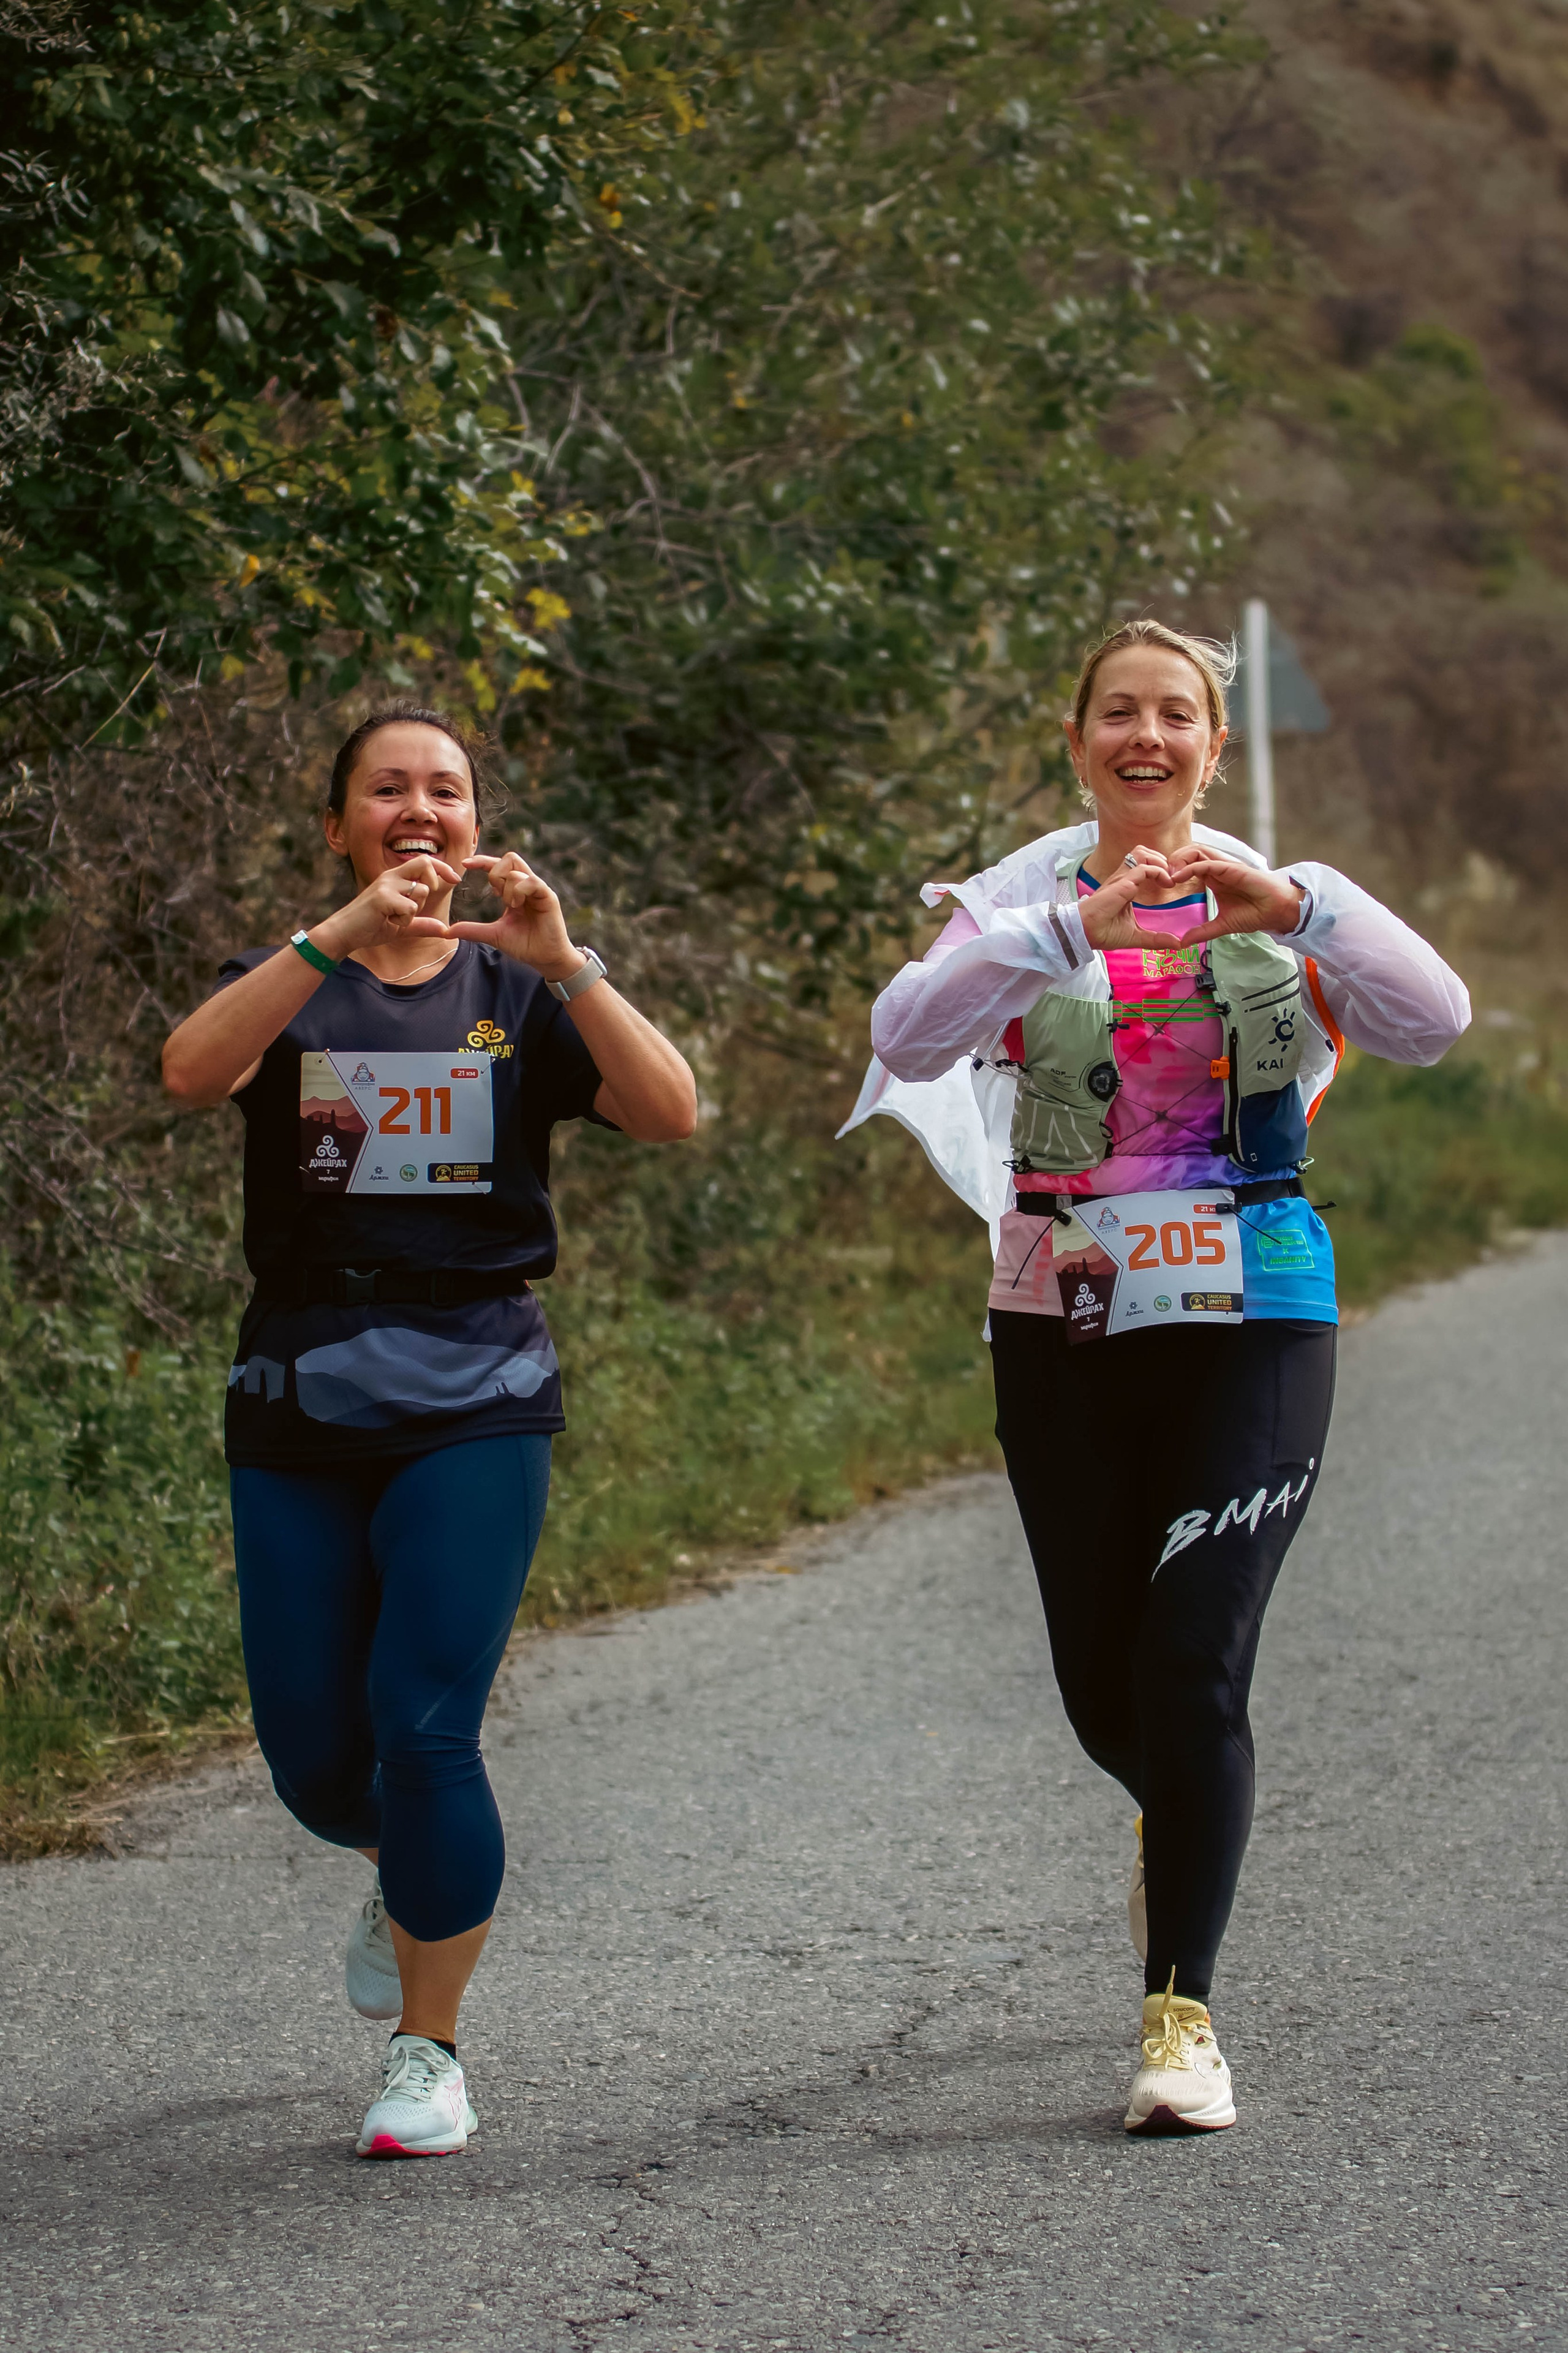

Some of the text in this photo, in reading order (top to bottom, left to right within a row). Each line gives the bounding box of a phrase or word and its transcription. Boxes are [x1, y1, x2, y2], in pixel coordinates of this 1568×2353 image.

[1143, 965, 1202, 978] МАРАФОН
[378, 1087, 451, 1135] 211
[309, 1158, 347, 1168] ДЖЕЙРАХ
[1125, 1220, 1226, 1271] 205
[1071, 1302, 1104, 1321] ДЖЕЙРАХ
